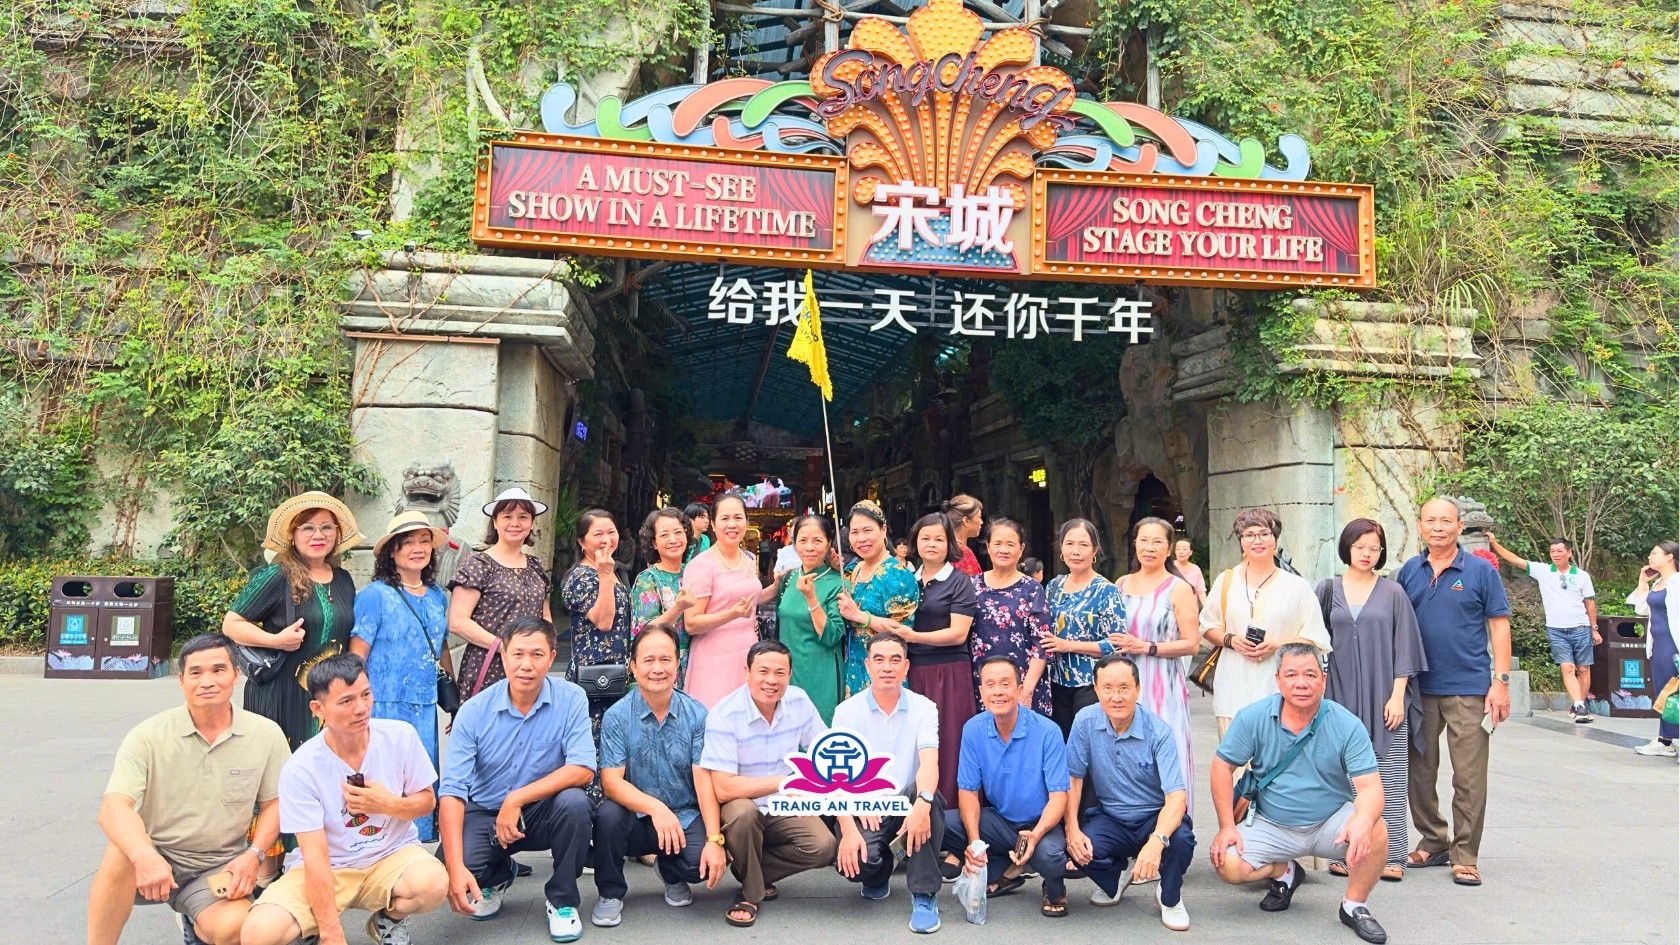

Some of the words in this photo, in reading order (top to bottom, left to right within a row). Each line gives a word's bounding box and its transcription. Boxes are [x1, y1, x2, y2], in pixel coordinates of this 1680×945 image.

[576, 163, 599, 192] A
[604, 166, 757, 204] MUST-SEE
[507, 191, 603, 224] SHOW
[608, 199, 642, 227] IN
[647, 201, 670, 229] A
[674, 203, 816, 239] LIFETIME
[871, 180, 1015, 255] 宋城
[1112, 197, 1191, 226] SONG
[1195, 202, 1293, 231] CHENG
[1083, 226, 1173, 256] STAGE
[1177, 230, 1257, 261] YOUR
[1261, 234, 1324, 263] LIFE
